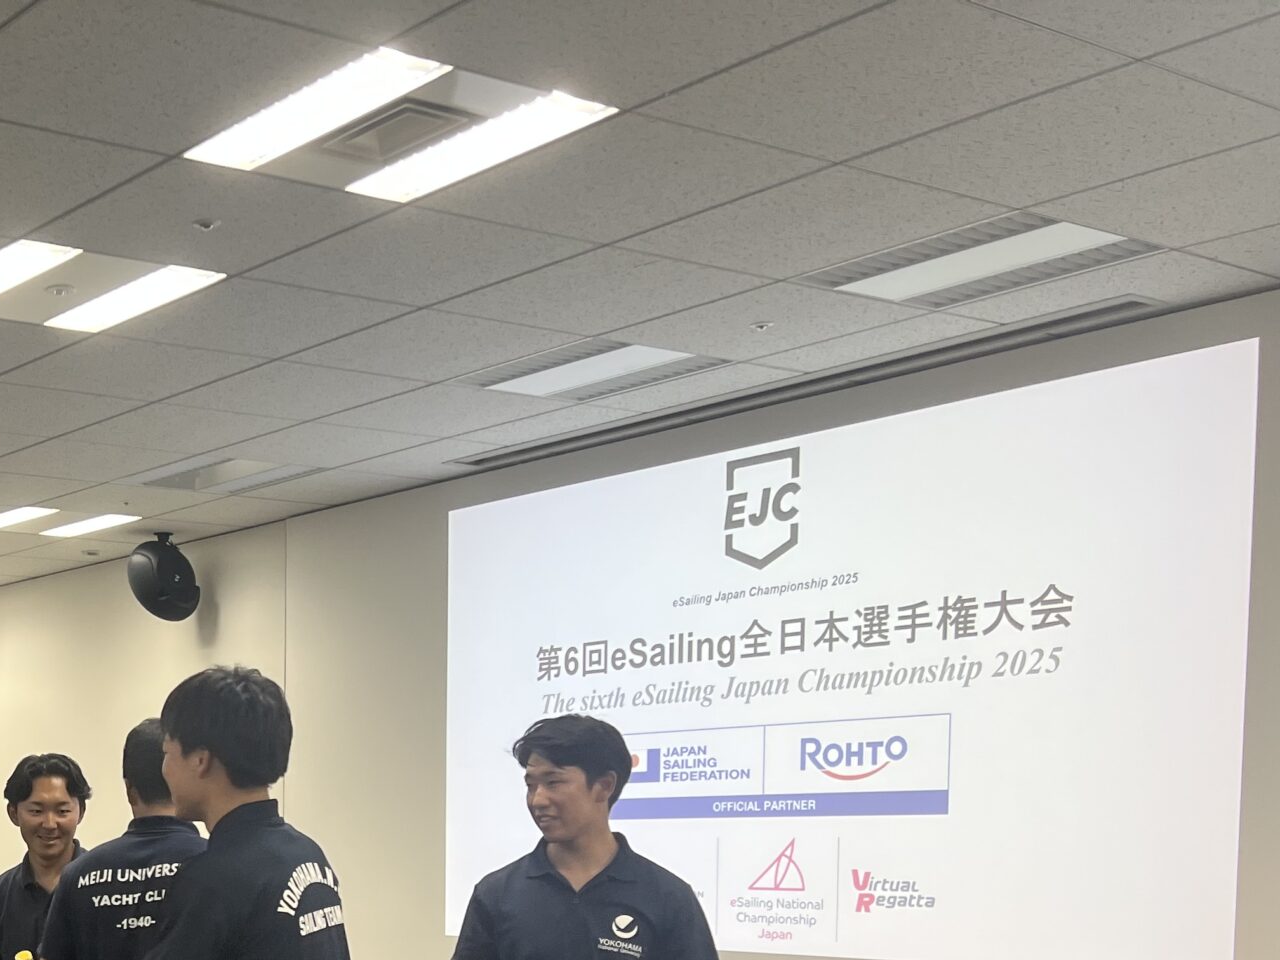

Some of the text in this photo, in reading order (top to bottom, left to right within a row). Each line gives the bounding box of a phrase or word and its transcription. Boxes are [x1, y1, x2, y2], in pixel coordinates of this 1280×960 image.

[724, 482, 801, 530] EJC
[672, 572, 860, 608] eSailing Japan Championship 2025
[536, 583, 1075, 682] 第6回eSailing全日本選手権大会
[542, 646, 1064, 714] The sixth eSailing Japan Championship 2025
[663, 745, 707, 757] JAPAN
[800, 735, 908, 771] ROHTO
[663, 757, 718, 770] SAILING
[663, 768, 751, 782] FEDERATION
[712, 799, 816, 813] OFFICIAL PARTNER
[77, 862, 182, 889] MEIJI UNIVERS
[91, 892, 141, 907] YACHT
[730, 897, 824, 911] eSailing National
[855, 892, 936, 913] Regatta
[736, 912, 817, 927] Championship
[758, 928, 793, 942] Japan
[598, 937, 643, 953] YOKOHAMA
